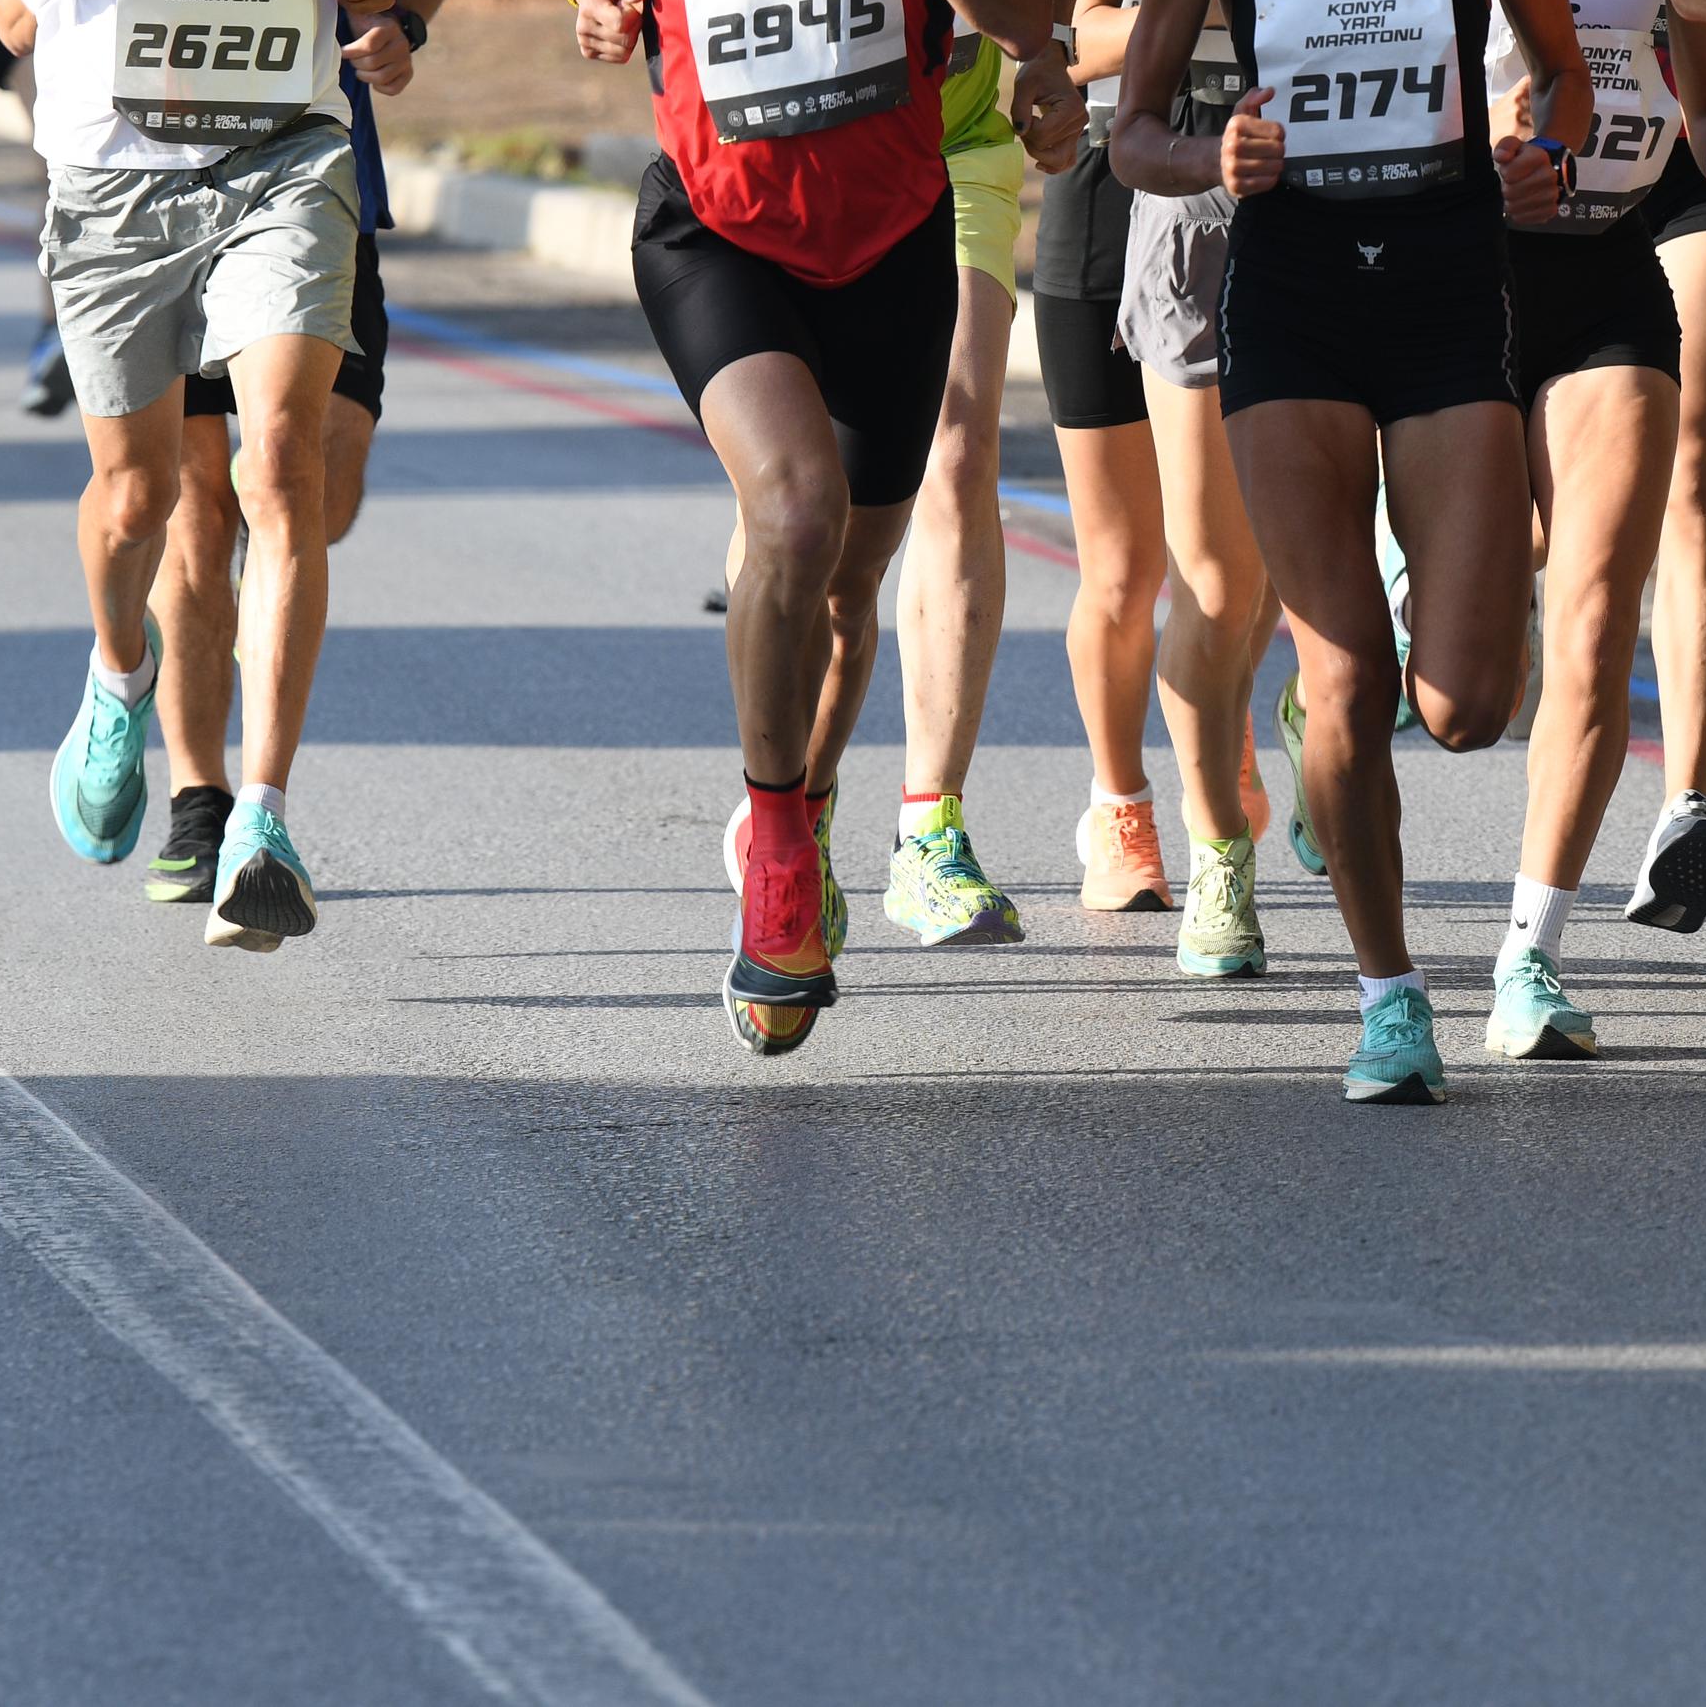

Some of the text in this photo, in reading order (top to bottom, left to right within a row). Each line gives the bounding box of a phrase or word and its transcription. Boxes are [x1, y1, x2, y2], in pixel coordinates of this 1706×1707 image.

[1327, 0, 1397, 17] KONYA
[1340, 15, 1385, 30] YARI
[1305, 27, 1423, 49] MARATONU
[125, 23, 301, 71] 2620
[1582, 47, 1632, 62] ONYA
[1587, 61, 1621, 75] ARI
[1288, 64, 1447, 123] 2174
[214, 120, 247, 130] KONYA
[1382, 169, 1418, 181] KONYA
